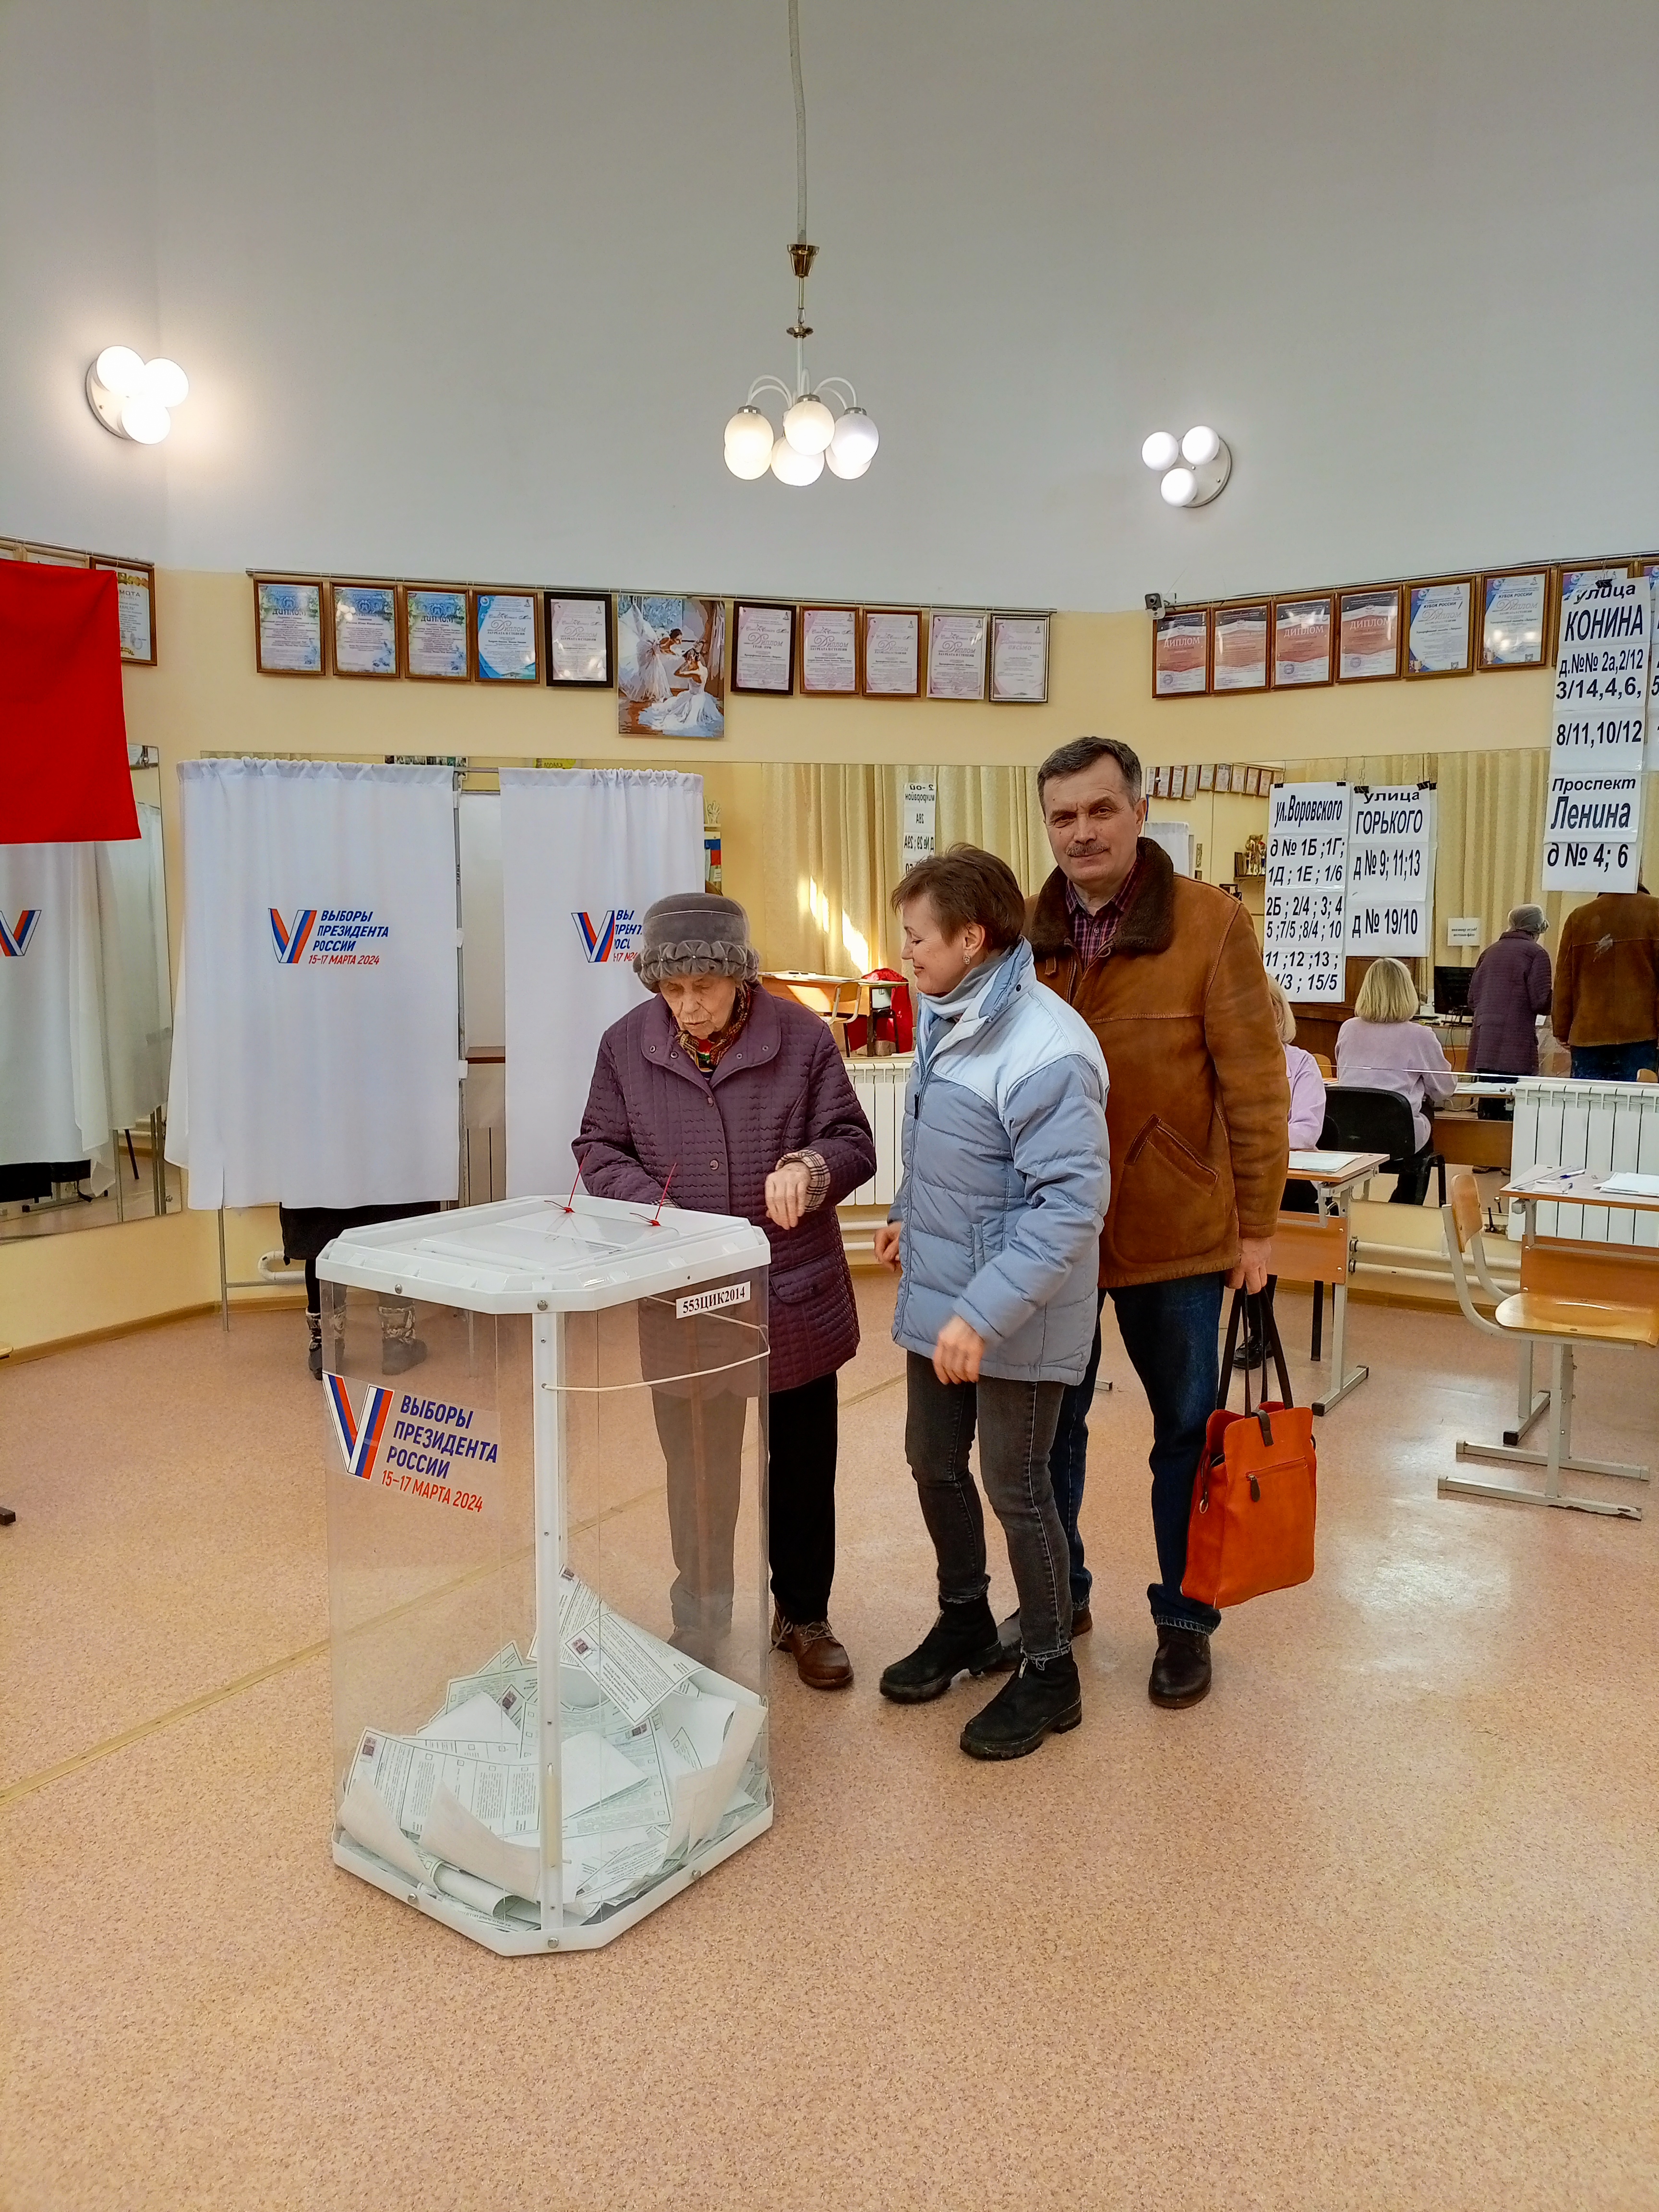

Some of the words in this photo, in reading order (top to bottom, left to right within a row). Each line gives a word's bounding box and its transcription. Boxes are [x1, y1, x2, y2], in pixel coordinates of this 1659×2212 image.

[1574, 584, 1635, 605] улица
[1284, 625, 1324, 638] ДИПЛОМ
[1564, 604, 1643, 642] КОНИНА
[1164, 637, 1200, 648] ДИПЛОМ
[1556, 720, 1643, 749] 8/11,10/12
[1552, 778, 1636, 794] Проспект
[1364, 792, 1419, 804] улица
[1274, 795, 1343, 828] ул.Воровского
[1356, 809, 1423, 834] ГОРЬКОГО
[1551, 796, 1631, 830] Ленина
[1282, 839, 1297, 856] №
[1301, 838, 1317, 855] 1Б
[1353, 856, 1361, 880] д
[1364, 849, 1377, 876] №
[1547, 843, 1559, 866] д
[1565, 843, 1588, 867] №
[1593, 843, 1611, 873] 4;
[1618, 844, 1629, 868] 6
[1297, 866, 1313, 882] 1Е
[1325, 865, 1343, 881] 1/6
[321, 910, 373, 922] ВЫБОРЫ
[1266, 897, 1281, 916] 2Б
[1293, 896, 1310, 915] 2/4
[1335, 896, 1343, 915] 4
[317, 925, 389, 938] ПРЕЗИДЕНТА
[1329, 920, 1342, 938] 10
[1352, 915, 1361, 938] д
[1365, 908, 1380, 934] №
[1384, 908, 1418, 935] 19/10
[313, 940, 356, 951] РОССИИ
[328, 955, 356, 964] МАРТА
[357, 955, 380, 965] 2024
[1265, 951, 1278, 967] 11
[1308, 974, 1338, 990] 15/5
[683, 1286, 745, 1313] 553ЦИК2014
[400, 1395, 474, 1429] ВЫБОРЫ
[393, 1420, 498, 1463] ПРЕЗИДЕНТА
[386, 1445, 451, 1479] РОССИИ
[412, 1479, 451, 1504] МАРТА
[453, 1490, 483, 1513] 2024
